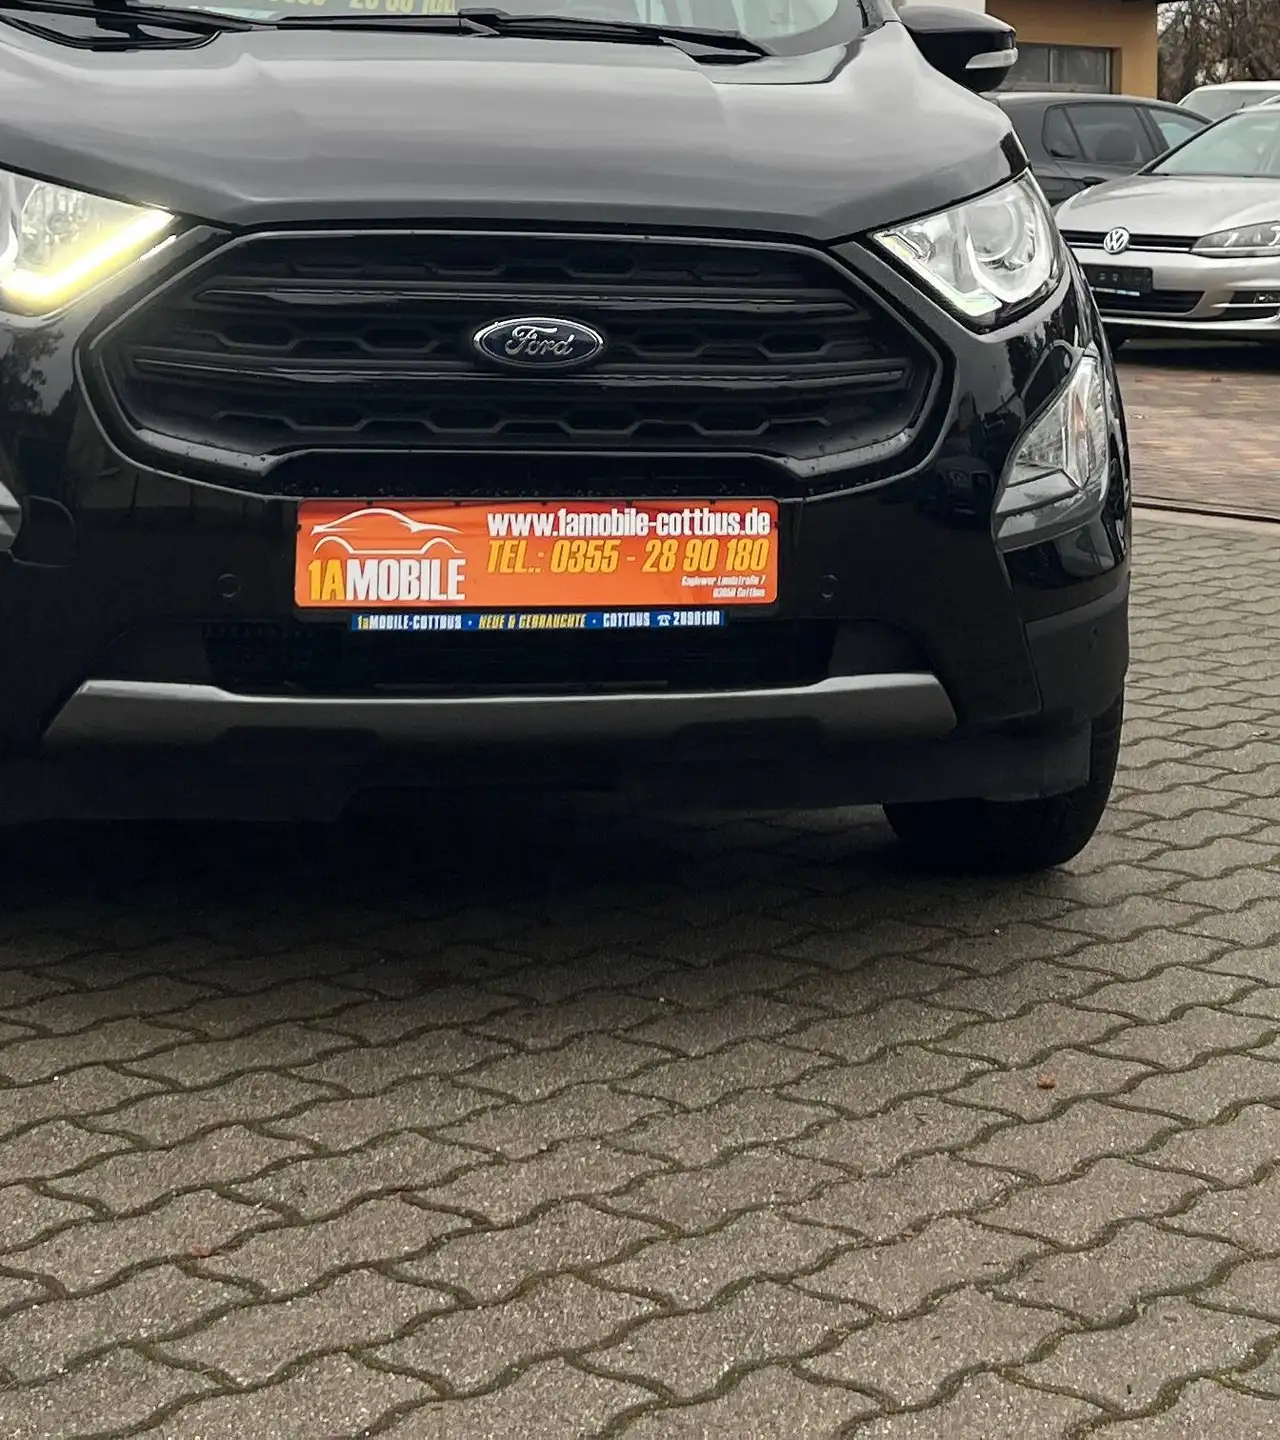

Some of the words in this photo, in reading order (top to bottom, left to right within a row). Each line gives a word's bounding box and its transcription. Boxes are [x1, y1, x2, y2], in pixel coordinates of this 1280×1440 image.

[505, 325, 575, 356] Ford
[487, 507, 771, 537] www.1amobile-cottbus.de
[487, 539, 544, 573] TEL.:
[550, 539, 621, 573] 0355
[642, 539, 678, 573] 28
[683, 538, 719, 572] 90
[725, 538, 770, 572] 180
[308, 559, 466, 601] 1AMOBILE
[603, 612, 650, 627] COTTBUS
